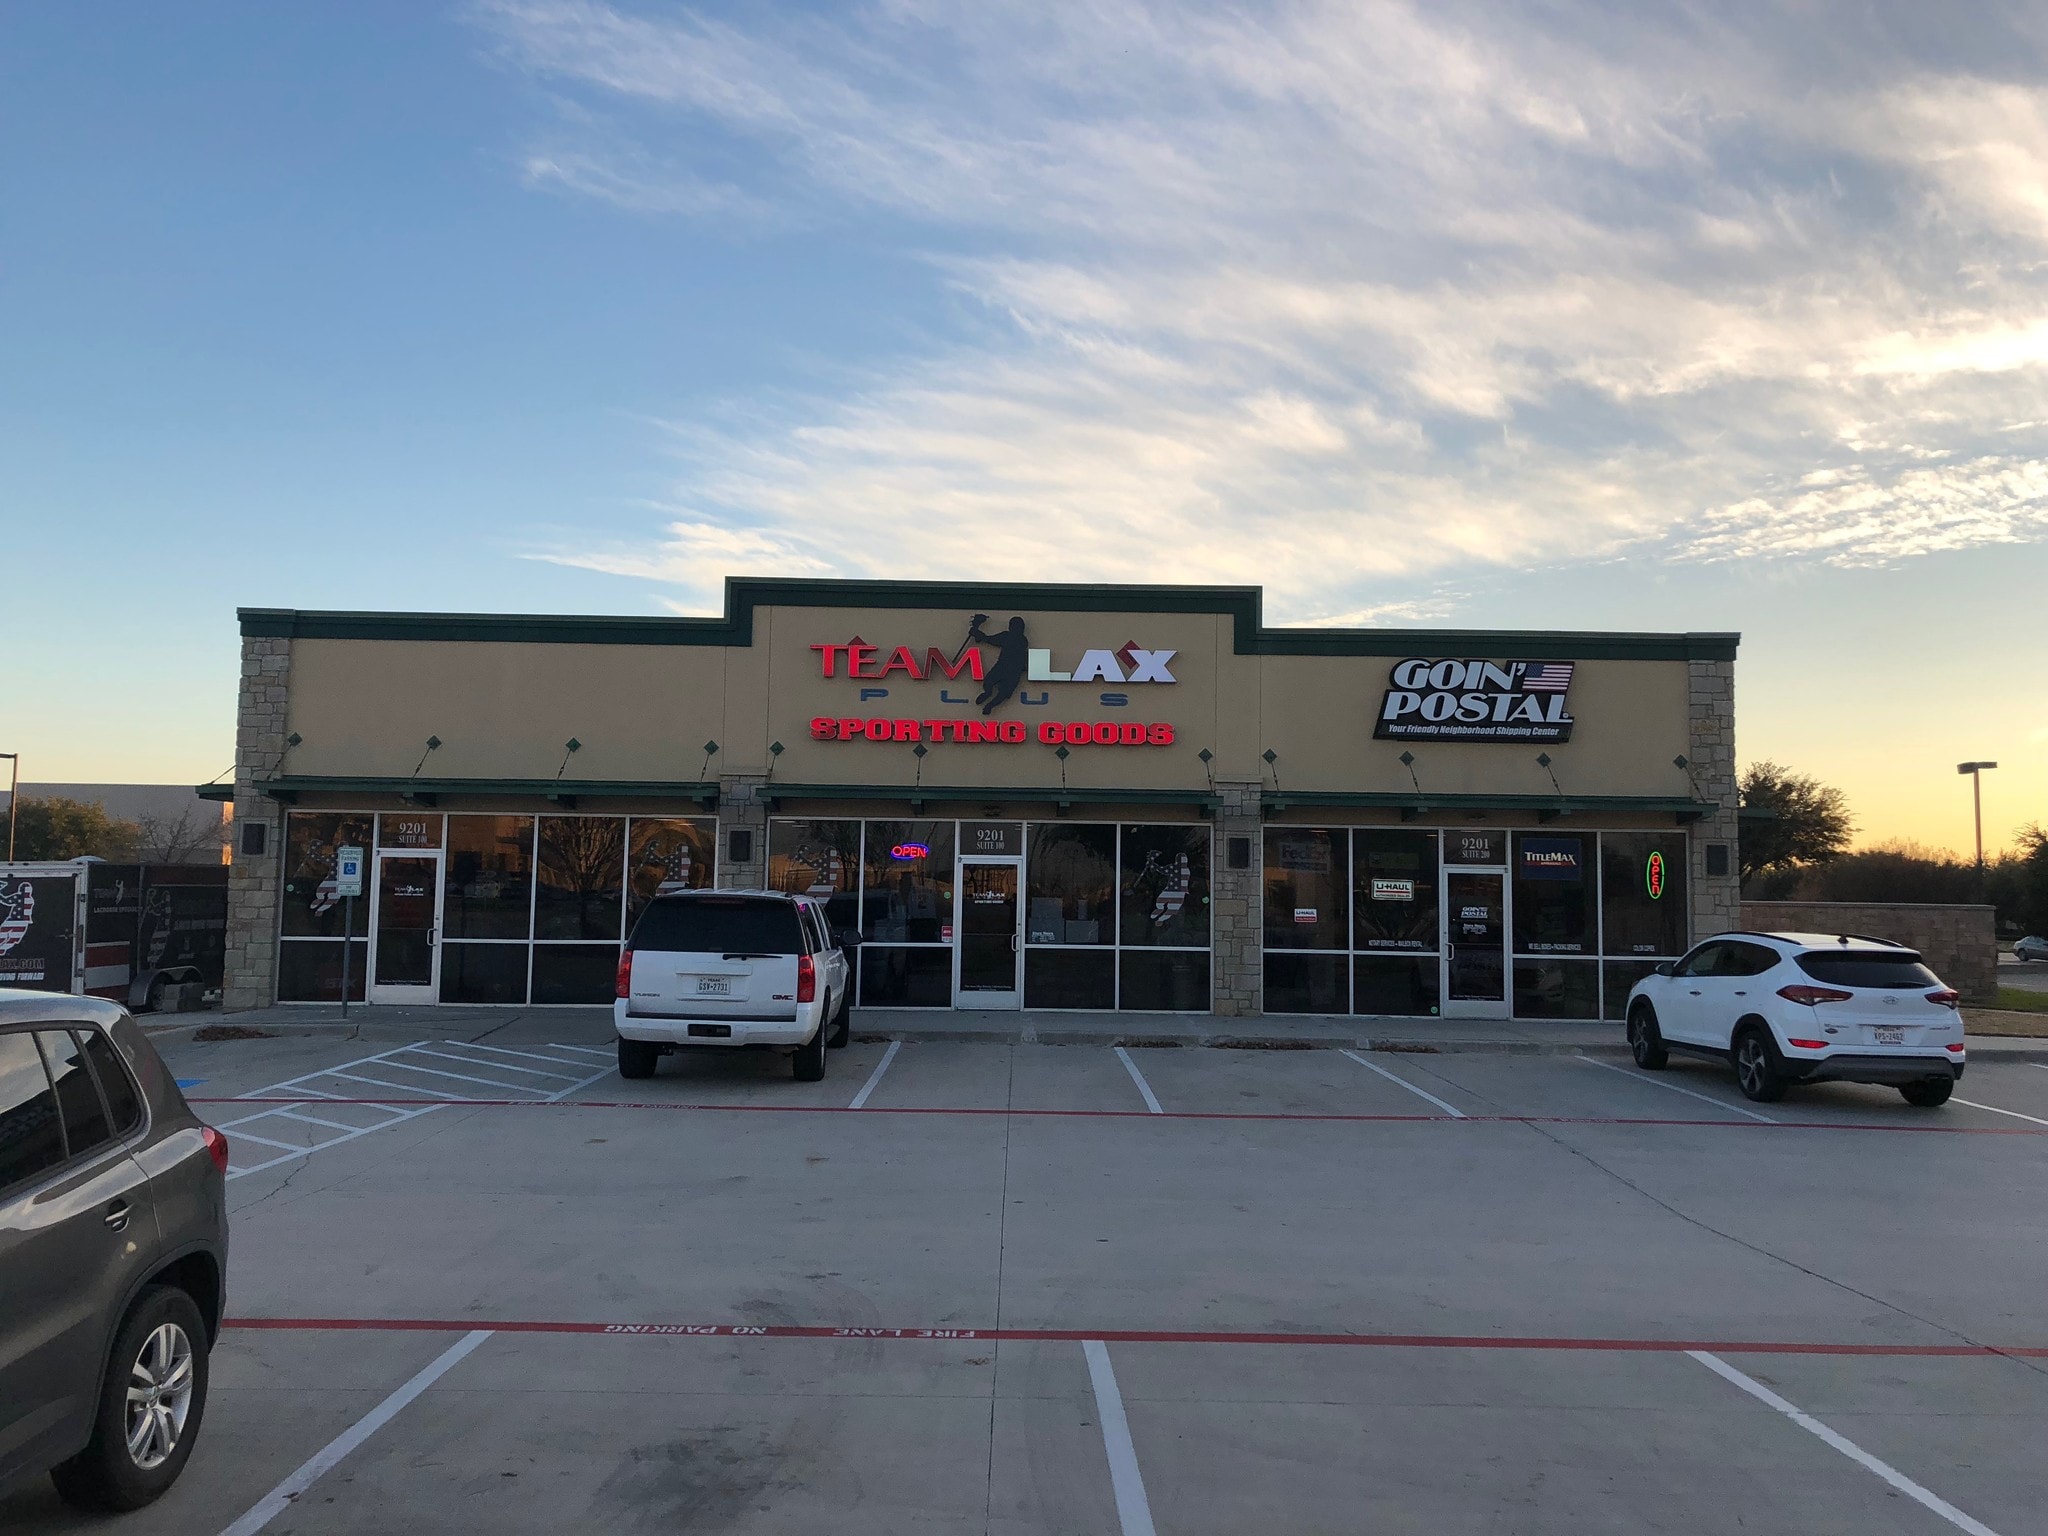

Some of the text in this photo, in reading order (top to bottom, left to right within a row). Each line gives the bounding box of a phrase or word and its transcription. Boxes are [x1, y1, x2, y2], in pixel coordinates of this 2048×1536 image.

[810, 644, 1178, 682] TEAM LAX
[1394, 660, 1527, 691] GOIN'
[860, 688, 1129, 707] PLUS
[1383, 691, 1574, 722] POSTAL
[809, 717, 1175, 745] SPORTING GOODS
[1388, 724, 1559, 737] Your Friendly Neighborhood Shipping Center
[399, 823, 427, 834] 9201
[398, 835, 417, 844] SUITE
[977, 829, 1004, 841] 9201
[976, 841, 995, 850] SUITE
[1461, 838, 1489, 850] 9201
[892, 845, 927, 858] OPEN
[1462, 850, 1480, 858] SUITE
[1651, 855, 1660, 895] OPEN
[604, 1324, 767, 1335] NO PARKING
[833, 1328, 975, 1339] FIRE LANE
